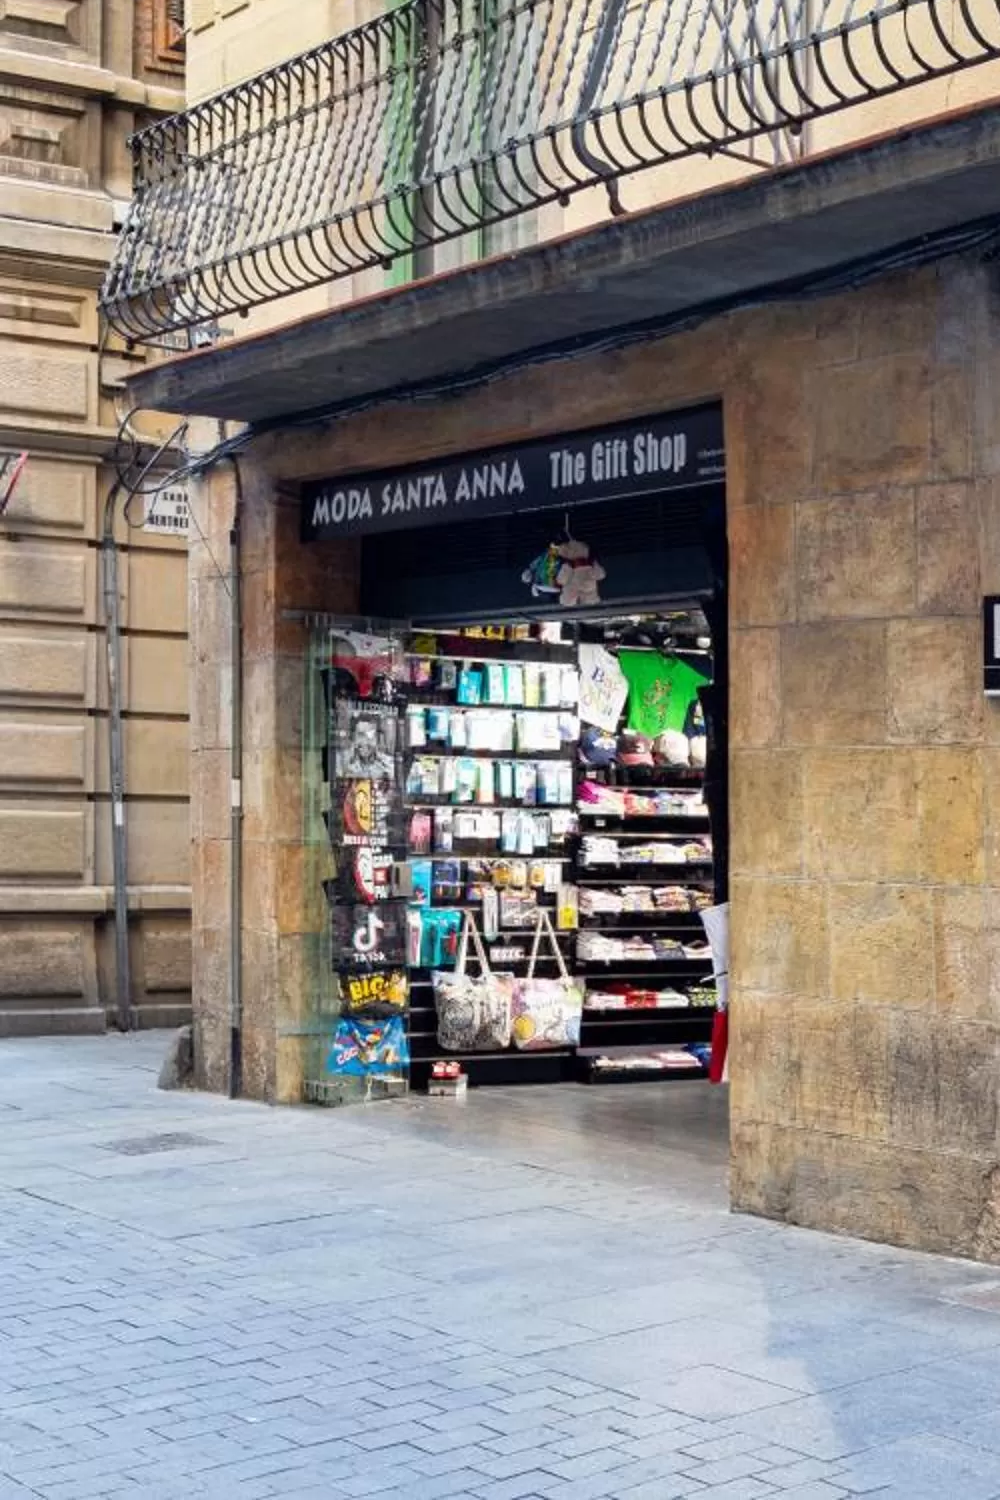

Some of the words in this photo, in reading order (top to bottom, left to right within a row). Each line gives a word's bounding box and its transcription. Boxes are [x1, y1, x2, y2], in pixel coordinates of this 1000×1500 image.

[311, 487, 374, 527] MODA
[381, 472, 448, 517] SANTA
[454, 457, 526, 504] ANNA
[549, 449, 587, 489] The
[590, 438, 629, 482] Gift
[633, 430, 687, 476] Shop
